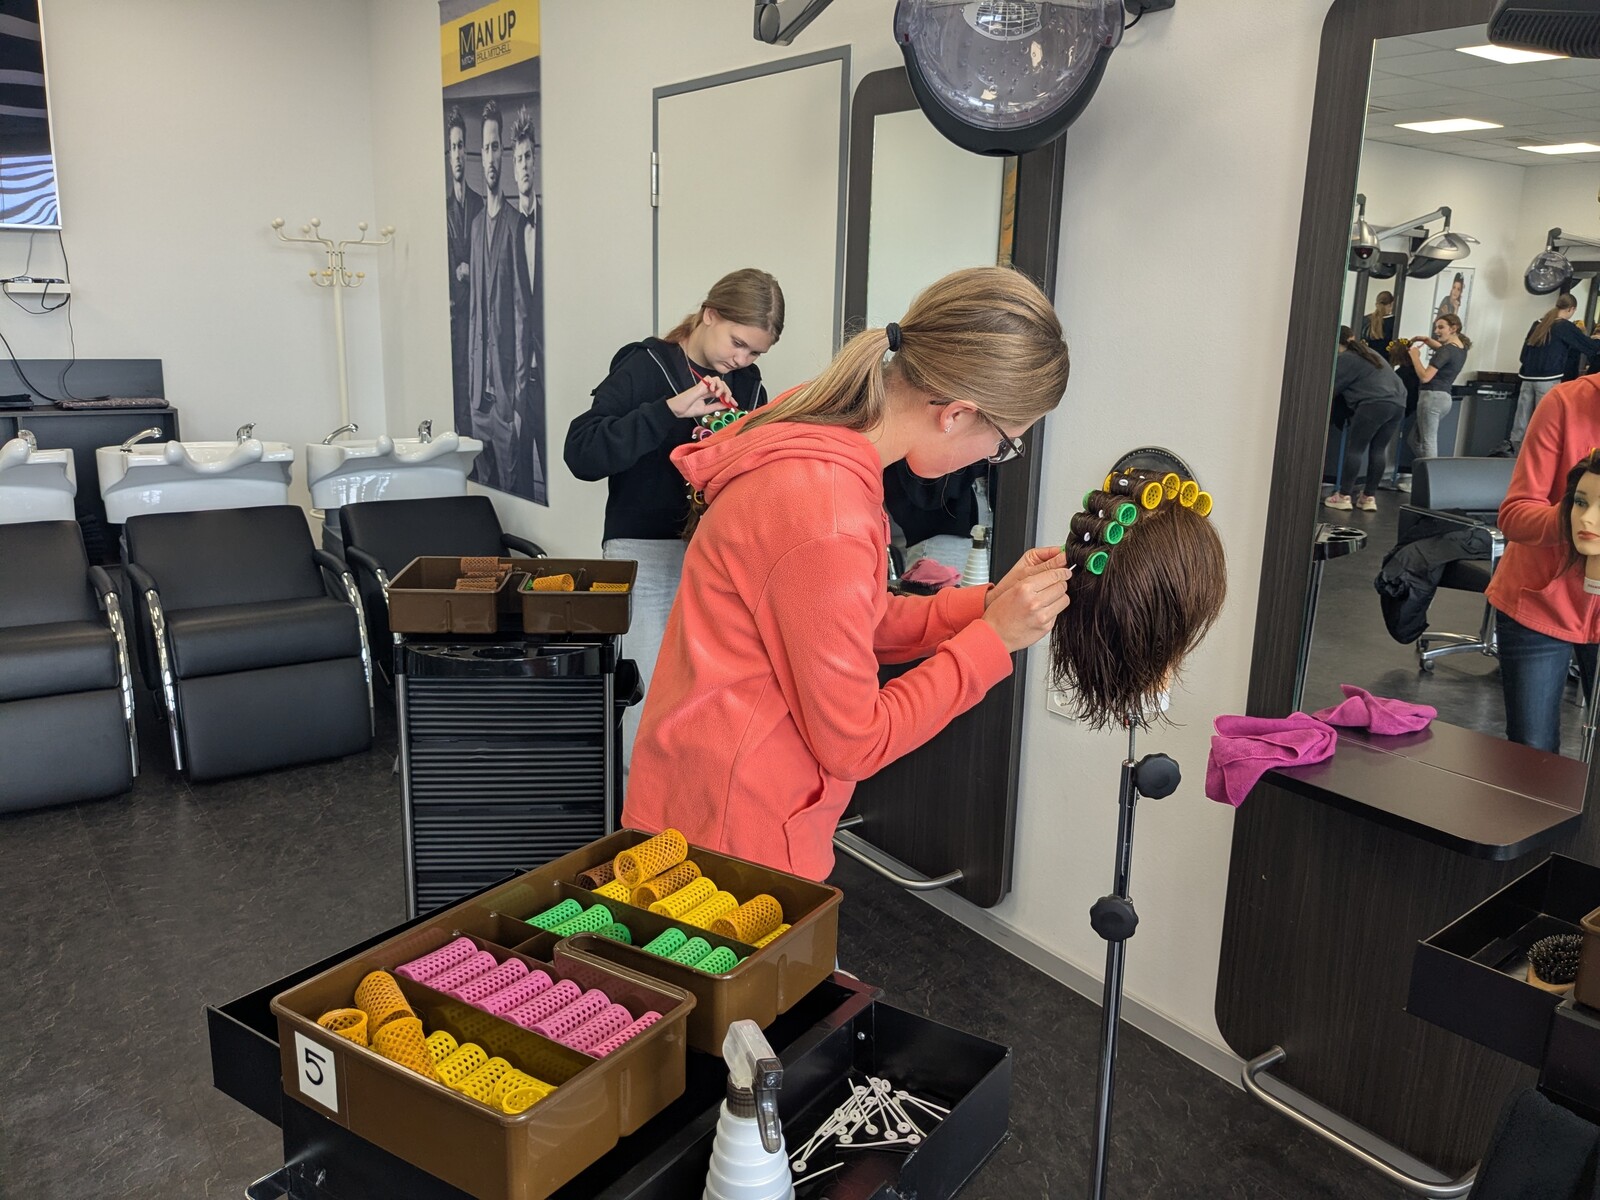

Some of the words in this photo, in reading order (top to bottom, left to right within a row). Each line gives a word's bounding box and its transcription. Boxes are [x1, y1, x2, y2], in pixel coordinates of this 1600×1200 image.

[461, 18, 494, 55] MAN
[498, 10, 516, 41] UP
[305, 1047, 327, 1086] 5
